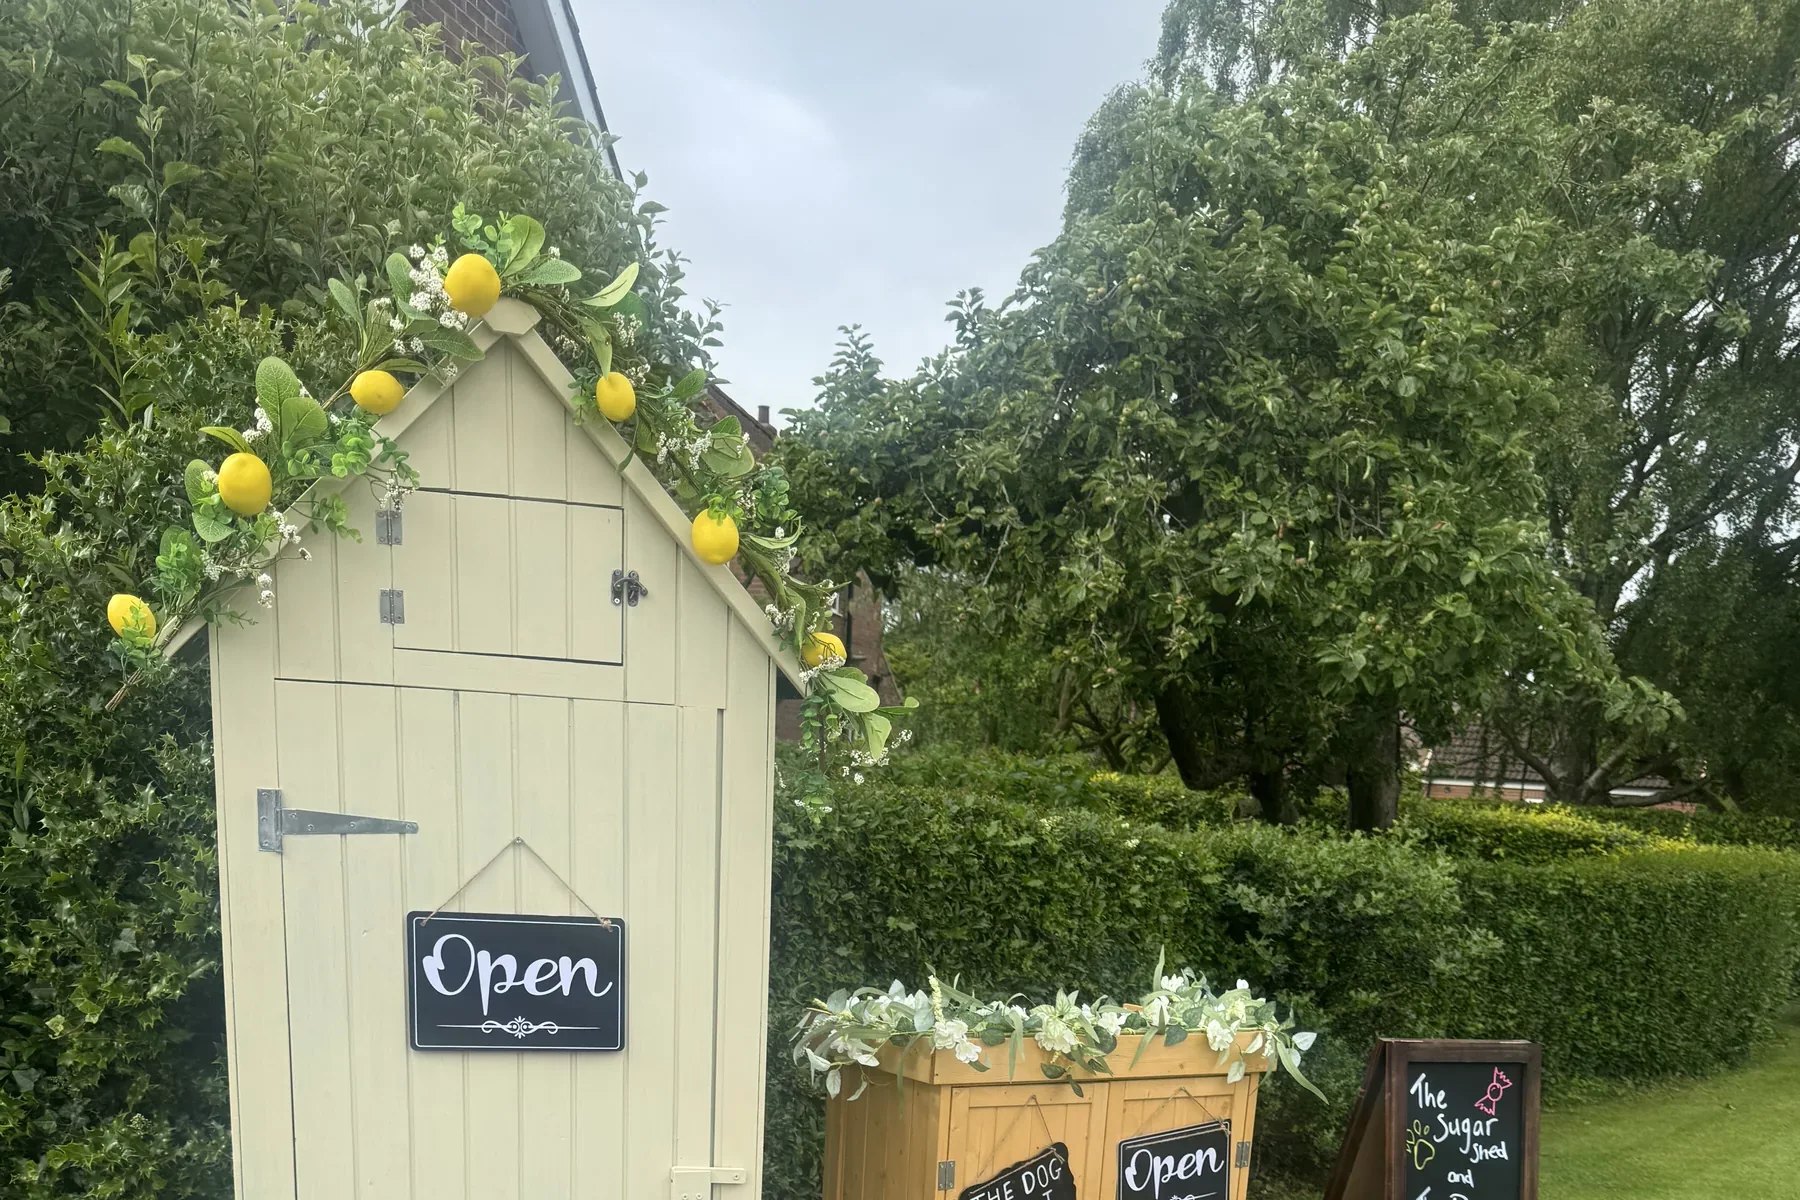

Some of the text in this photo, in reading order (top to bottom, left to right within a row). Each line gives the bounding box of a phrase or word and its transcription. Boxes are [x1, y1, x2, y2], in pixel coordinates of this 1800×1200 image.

[422, 933, 613, 1016] Open
[1410, 1072, 1448, 1110] The
[1432, 1112, 1499, 1154] Sugar
[1020, 1157, 1063, 1195] DOG
[1124, 1147, 1224, 1200] Open
[1447, 1169, 1475, 1189] and
